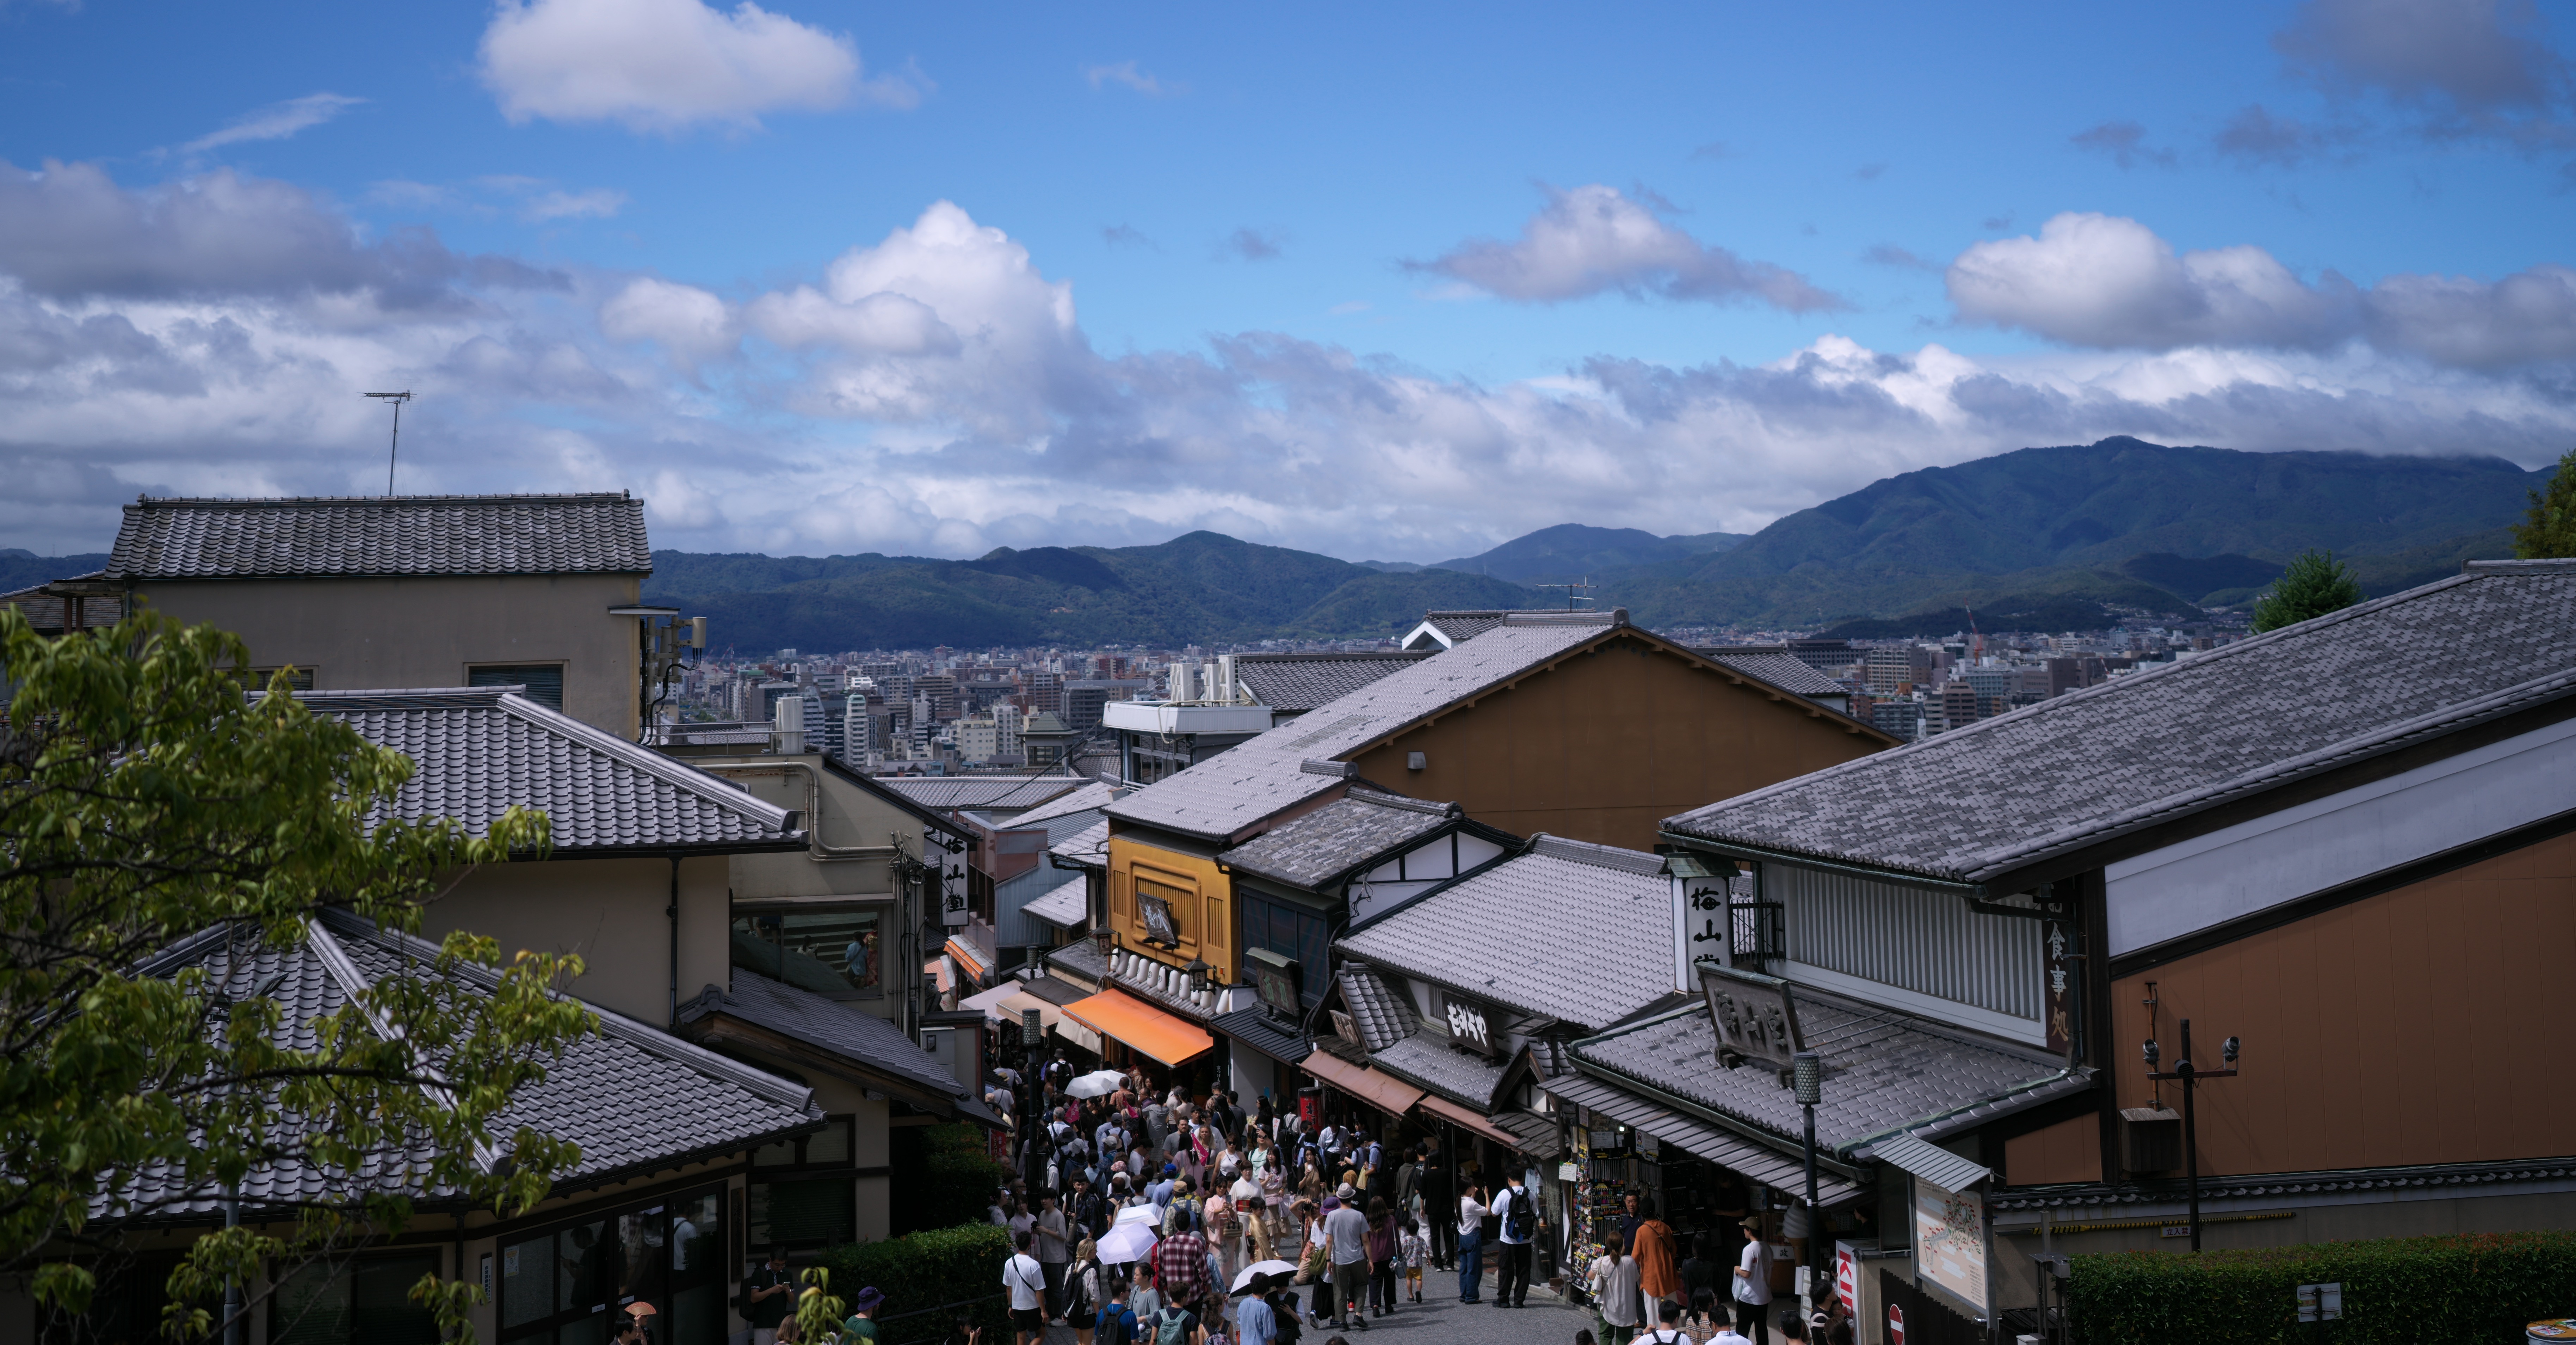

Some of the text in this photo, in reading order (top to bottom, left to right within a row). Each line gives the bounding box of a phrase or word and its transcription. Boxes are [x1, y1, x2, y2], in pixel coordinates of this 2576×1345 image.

[945, 837, 967, 913] 梅山堂
[2047, 883, 2069, 1042] 食事処
[1447, 1001, 1488, 1048] もみぢや
[2166, 1227, 2191, 1236] 立入禁
